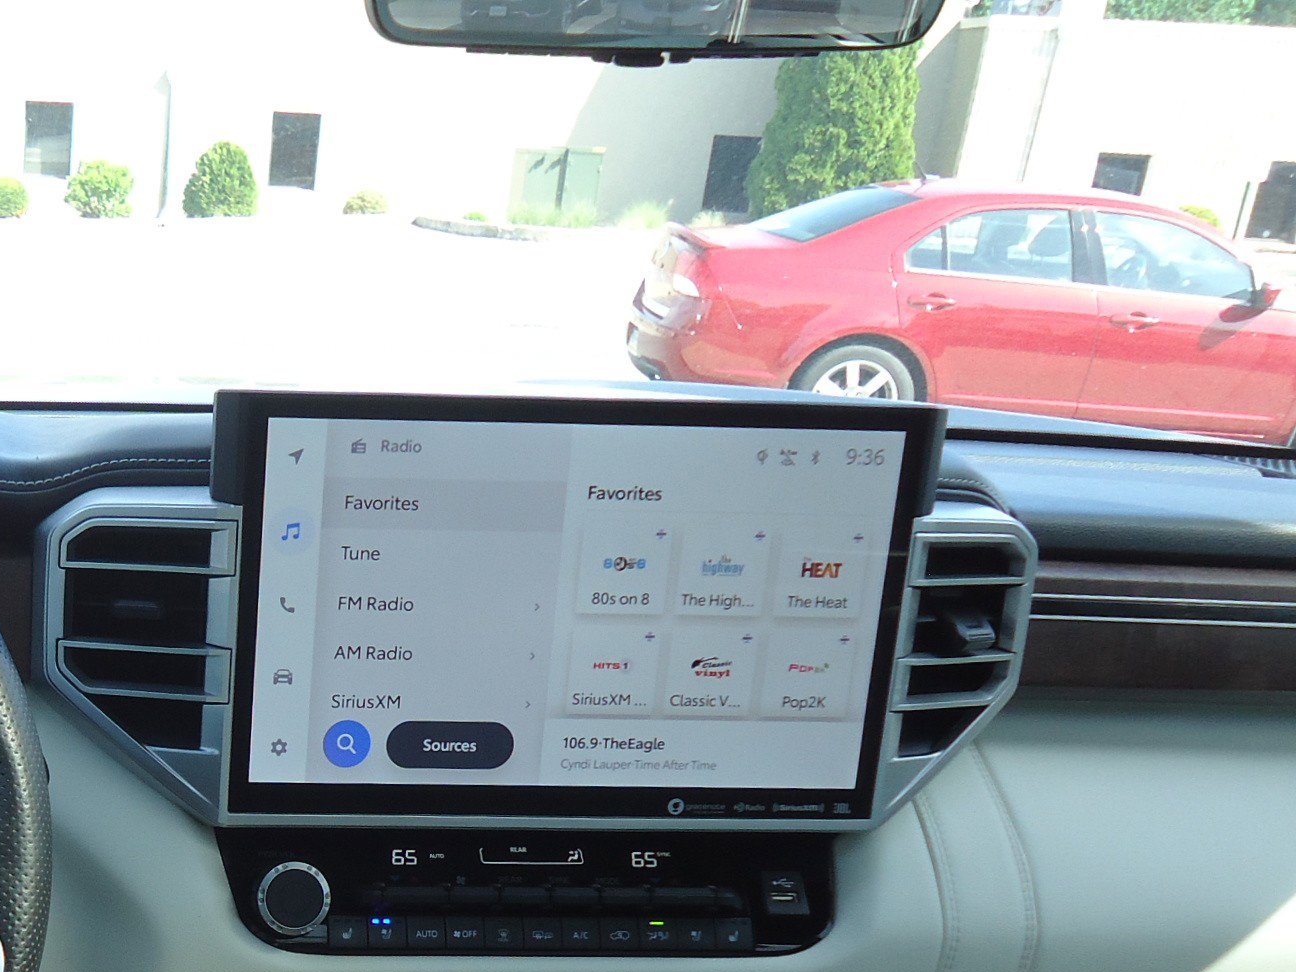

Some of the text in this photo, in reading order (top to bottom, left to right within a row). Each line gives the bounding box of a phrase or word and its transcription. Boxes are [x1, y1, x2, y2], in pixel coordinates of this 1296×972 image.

[380, 439, 423, 454] Radio
[846, 448, 886, 466] 9:36
[587, 486, 663, 501] Favorites
[344, 495, 420, 512] Favorites
[341, 546, 381, 561] Tune
[801, 562, 843, 578] HEAT
[337, 596, 414, 612] FM Radio
[592, 592, 650, 605] 80s on 8
[682, 593, 706, 606] The
[788, 595, 848, 609] The Heat
[333, 645, 413, 661] AM Radio
[593, 661, 621, 670] HITS
[331, 694, 402, 710] SiriusXM
[572, 693, 631, 706] SiriusXM
[669, 695, 716, 708] Classic
[782, 696, 826, 711] Pop2K
[422, 738, 477, 753] Sources
[560, 758, 718, 771] Cyndi Lauper Time After Time
[391, 849, 418, 866] 65
[631, 851, 658, 867] 65
[415, 930, 438, 938] AUTO
[462, 930, 478, 938] OFF
[573, 931, 589, 940] A/C
